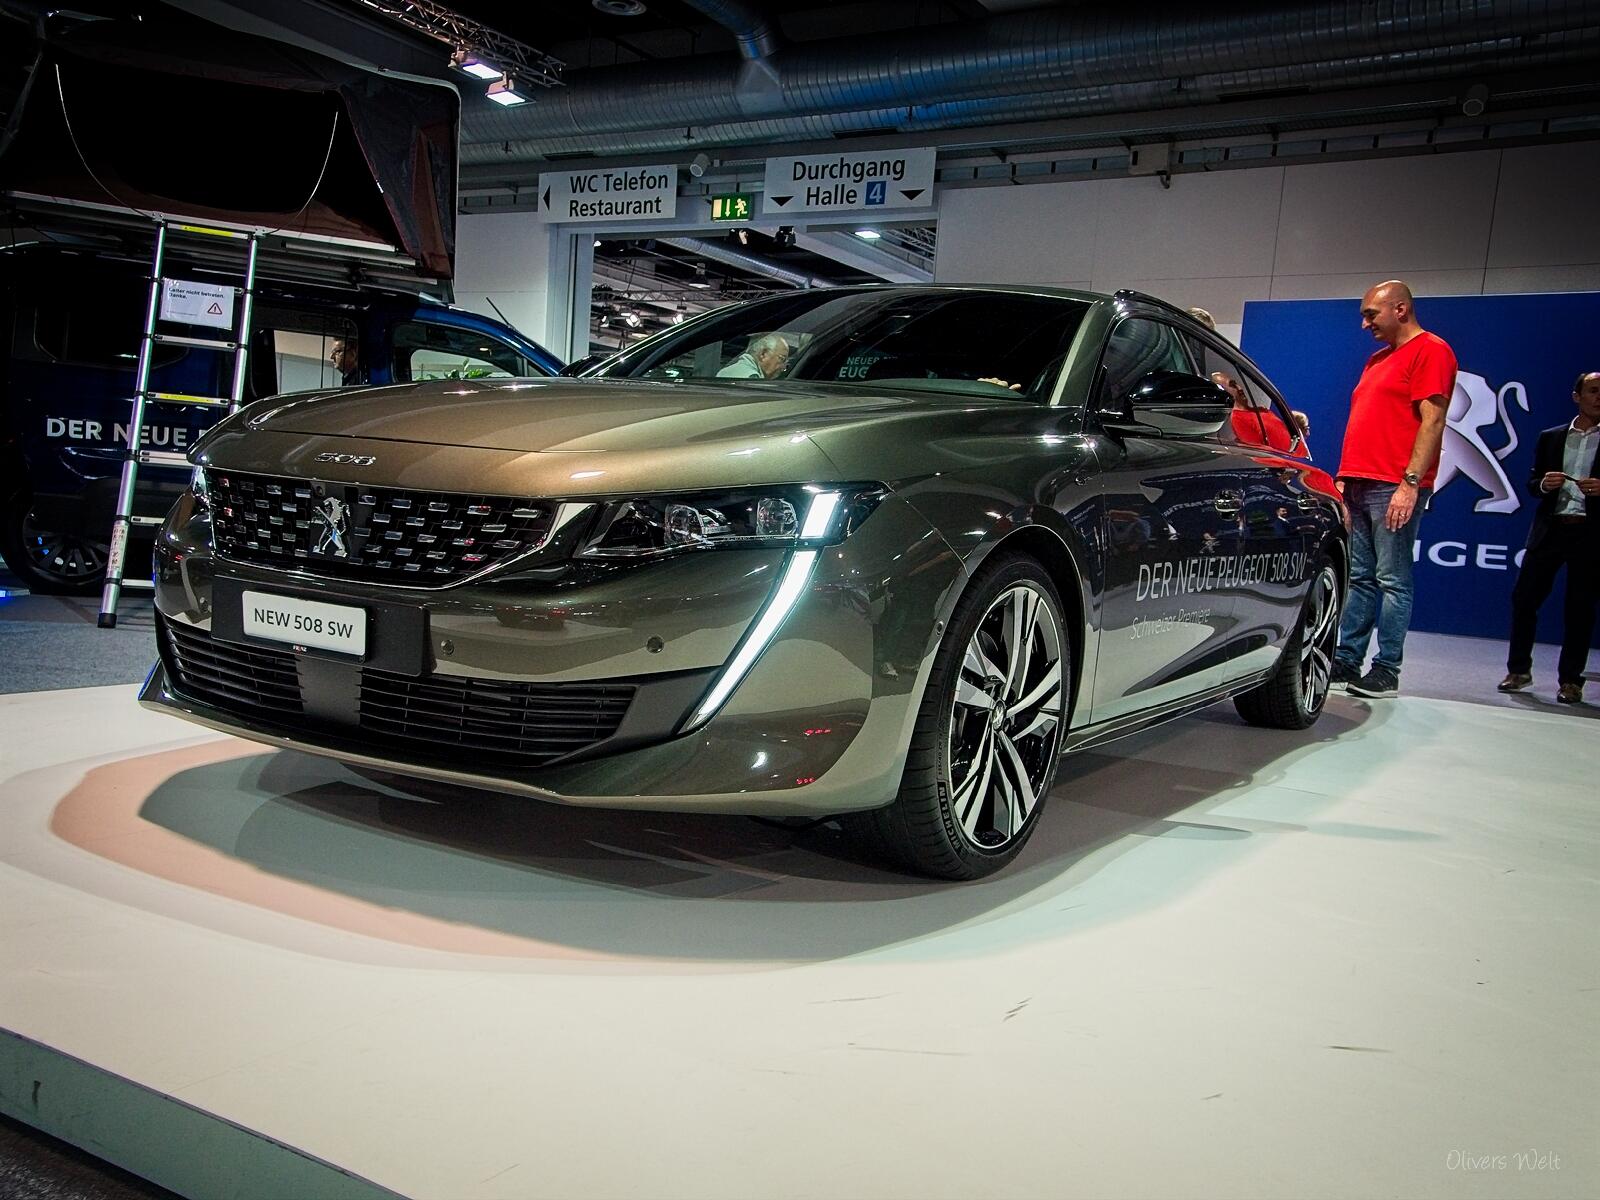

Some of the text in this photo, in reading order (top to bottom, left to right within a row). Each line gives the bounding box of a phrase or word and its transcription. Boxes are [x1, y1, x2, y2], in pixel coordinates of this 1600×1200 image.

[570, 170, 668, 194] WC Telefon
[793, 157, 906, 183] Durchgang
[806, 182, 883, 206] Halle 4
[569, 197, 662, 218] Restaurant
[46, 418, 188, 447] DER NEUE
[314, 452, 376, 466] 508
[1136, 551, 1308, 602] DER NEUE PEUGEOT 508 SW
[254, 607, 353, 638] NEW 508 SW
[1130, 613, 1176, 640] Schweizer
[938, 786, 962, 851] MICHELIN
